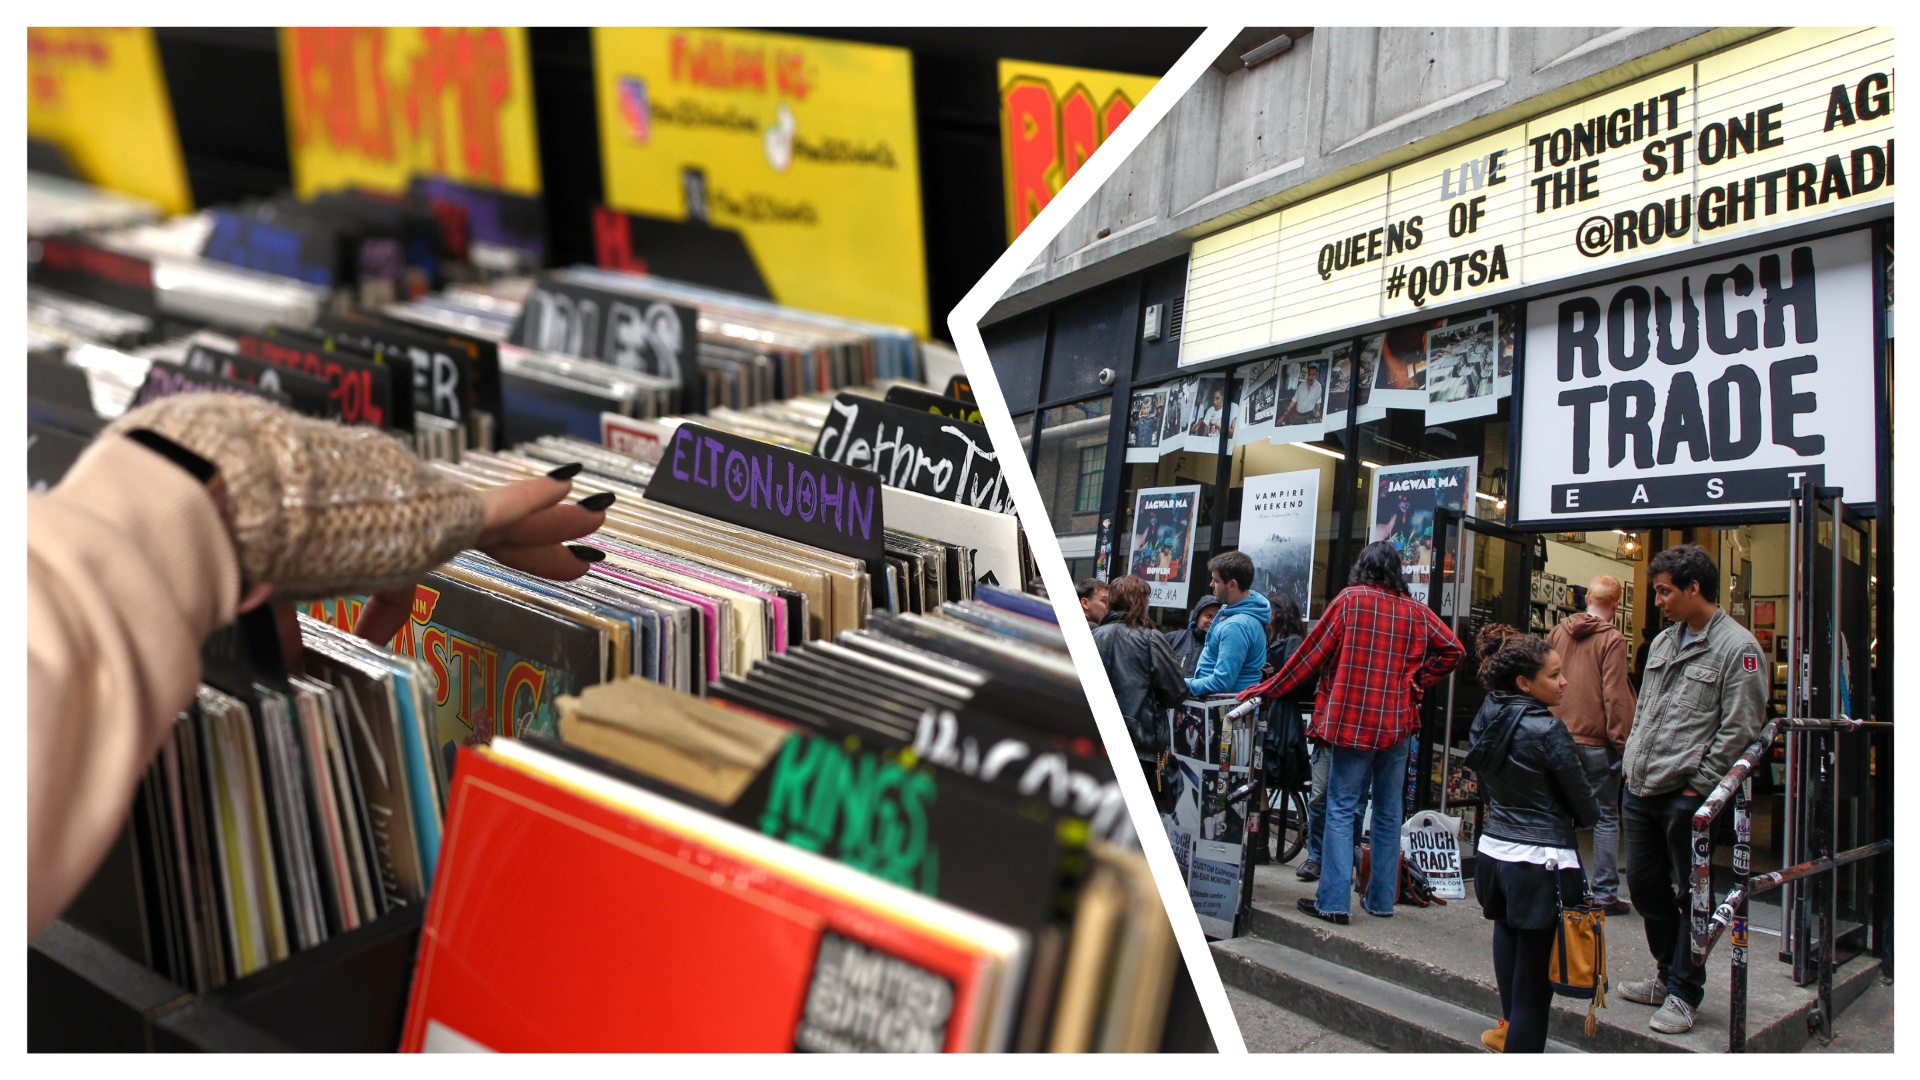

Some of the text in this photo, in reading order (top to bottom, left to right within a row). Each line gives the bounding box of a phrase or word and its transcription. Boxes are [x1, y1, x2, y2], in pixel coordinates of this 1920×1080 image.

[1441, 86, 1686, 201] LIVE TONIGHT
[1318, 68, 1894, 281] QUEENS OF THE STONE AG
[1387, 244, 1509, 307] #QOTSA
[1557, 246, 1818, 382] ROUGH
[1558, 355, 1825, 474] TRADE
[819, 398, 953, 494] Jethro
[673, 428, 874, 540] ELTON JOHN
[1256, 489, 1304, 500] VAMPIRE
[1388, 476, 1458, 493] JAGWAR MA
[1566, 472, 1806, 508] EAST
[1145, 499, 1187, 510] JAGWAR MA
[1254, 500, 1303, 511] WEEKEND
[1147, 567, 1170, 575] HOWLIN
[1401, 565, 1430, 575] OWLI
[762, 731, 938, 868] KINGS
[1409, 831, 1456, 850] ROUGH
[1192, 861, 1214, 873] CUSTOM
[1410, 850, 1459, 871] TRADE
[1192, 871, 1231, 886] IN-EAR MONITORS
